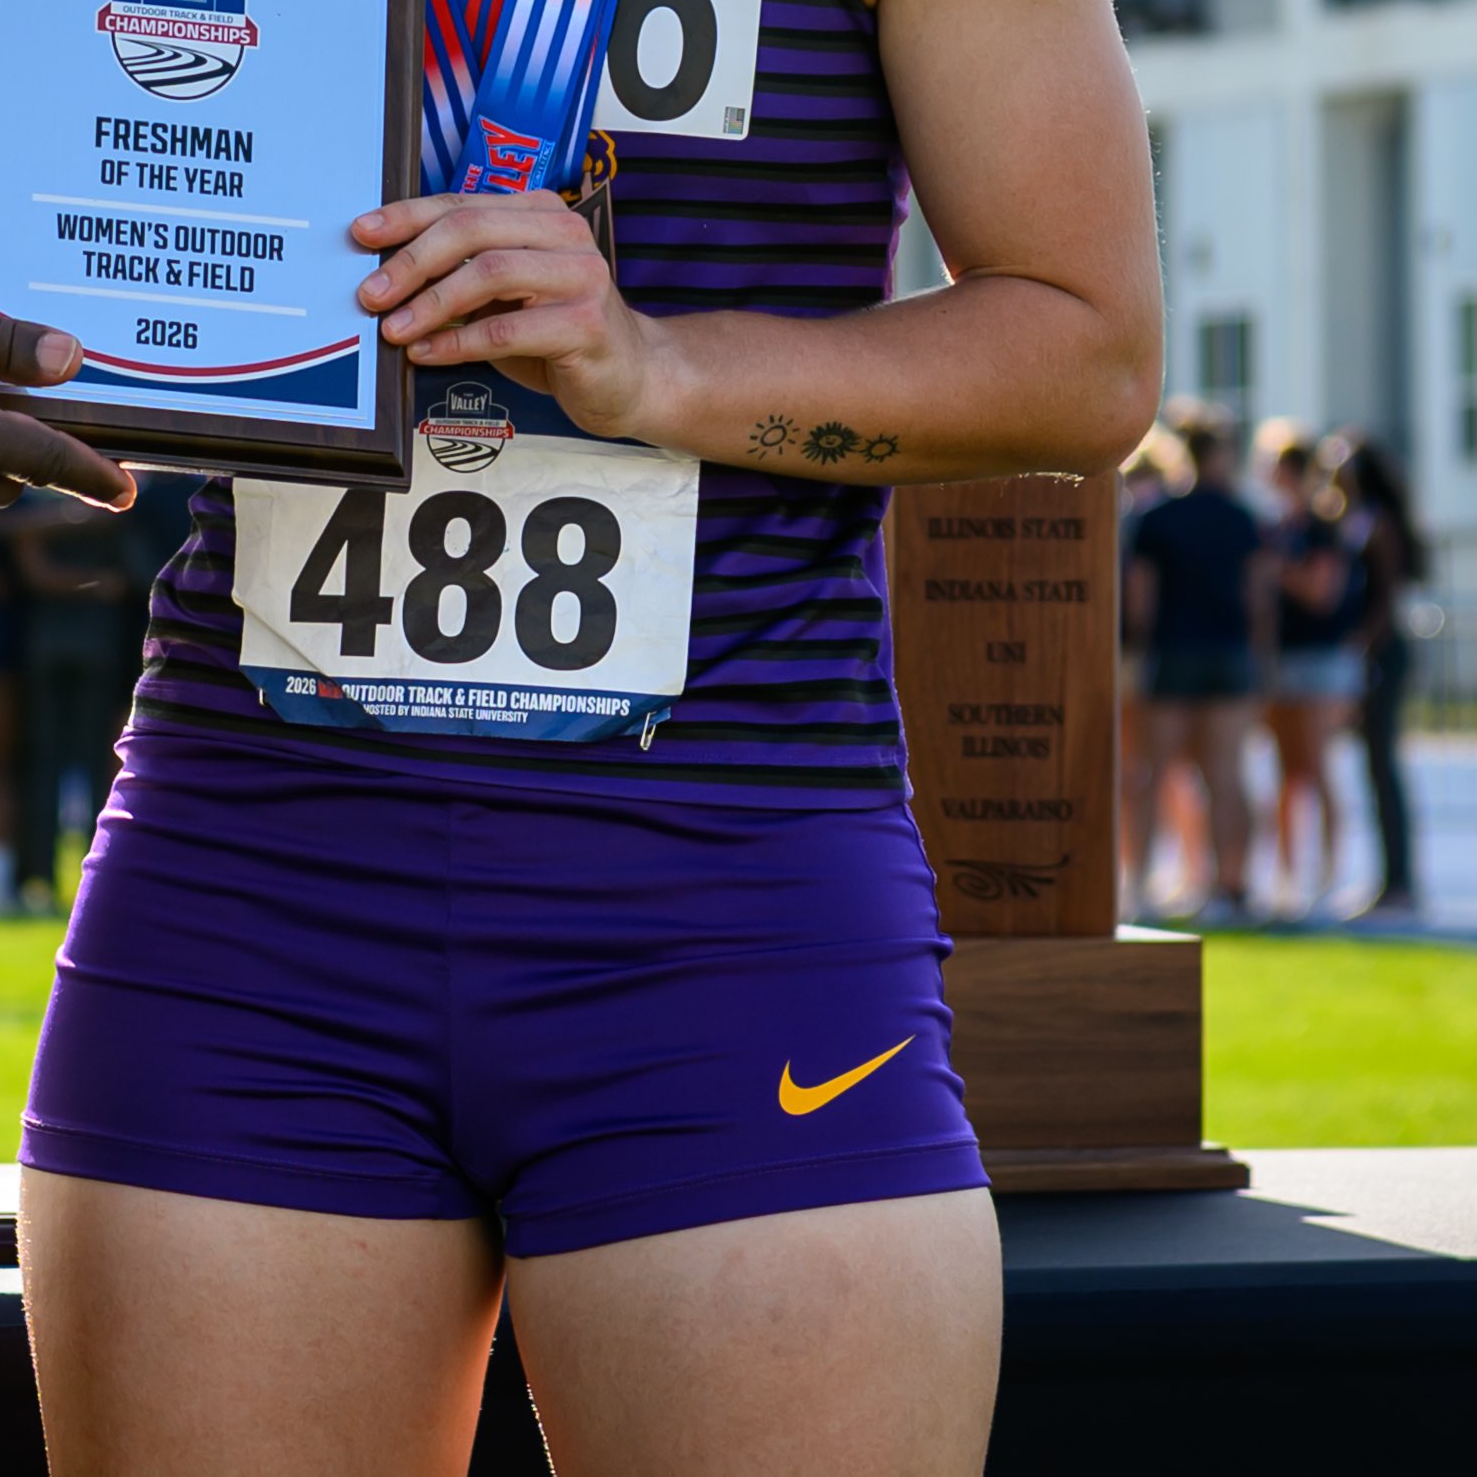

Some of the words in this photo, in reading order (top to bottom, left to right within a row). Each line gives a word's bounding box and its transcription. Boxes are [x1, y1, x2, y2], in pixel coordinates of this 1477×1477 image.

[122, 5, 167, 18] OUTDOOR
[169, 9, 198, 21] TRACK
[199, 13, 207, 22] &
[208, 14, 234, 24] FIELD
[104, 14, 251, 45] CHAMPIONSHIPS
[94, 116, 254, 163] FRESHMAN
[100, 159, 130, 186] OF
[135, 162, 179, 192] THE
[183, 167, 244, 198] YEAR
[56, 213, 169, 250] WOMEN'S
[174, 225, 284, 262] OUTDOOR
[82, 250, 161, 284] TRACK
[165, 258, 183, 287] &
[187, 260, 256, 293] FIELD
[135, 317, 199, 350] 2026
[450, 392, 488, 411] VALLEY
[423, 425, 510, 438] CHAMPIONSHIPS
[927, 517, 1017, 540] ILLINOIS
[1022, 517, 1086, 540] STATE
[289, 488, 623, 672] 488
[924, 578, 1019, 602] INDIANA
[1023, 579, 1088, 603] STATE
[986, 640, 1027, 664] UNI
[285, 675, 317, 696] 2026
[341, 683, 405, 703] OUTDOOR
[407, 686, 453, 706] TRACK
[454, 687, 466, 706] &
[467, 688, 508, 709] FIELD
[509, 691, 631, 717] CHAMPIONSHIPS
[397, 704, 410, 717] BY
[411, 705, 447, 719] INDIANA
[448, 707, 474, 720] STATE
[475, 709, 529, 724] UNIVERSITY
[948, 702, 1064, 726] SOUTHERN
[962, 735, 1051, 759] ILLINOIS
[939, 797, 1073, 820] VALPARAISO
